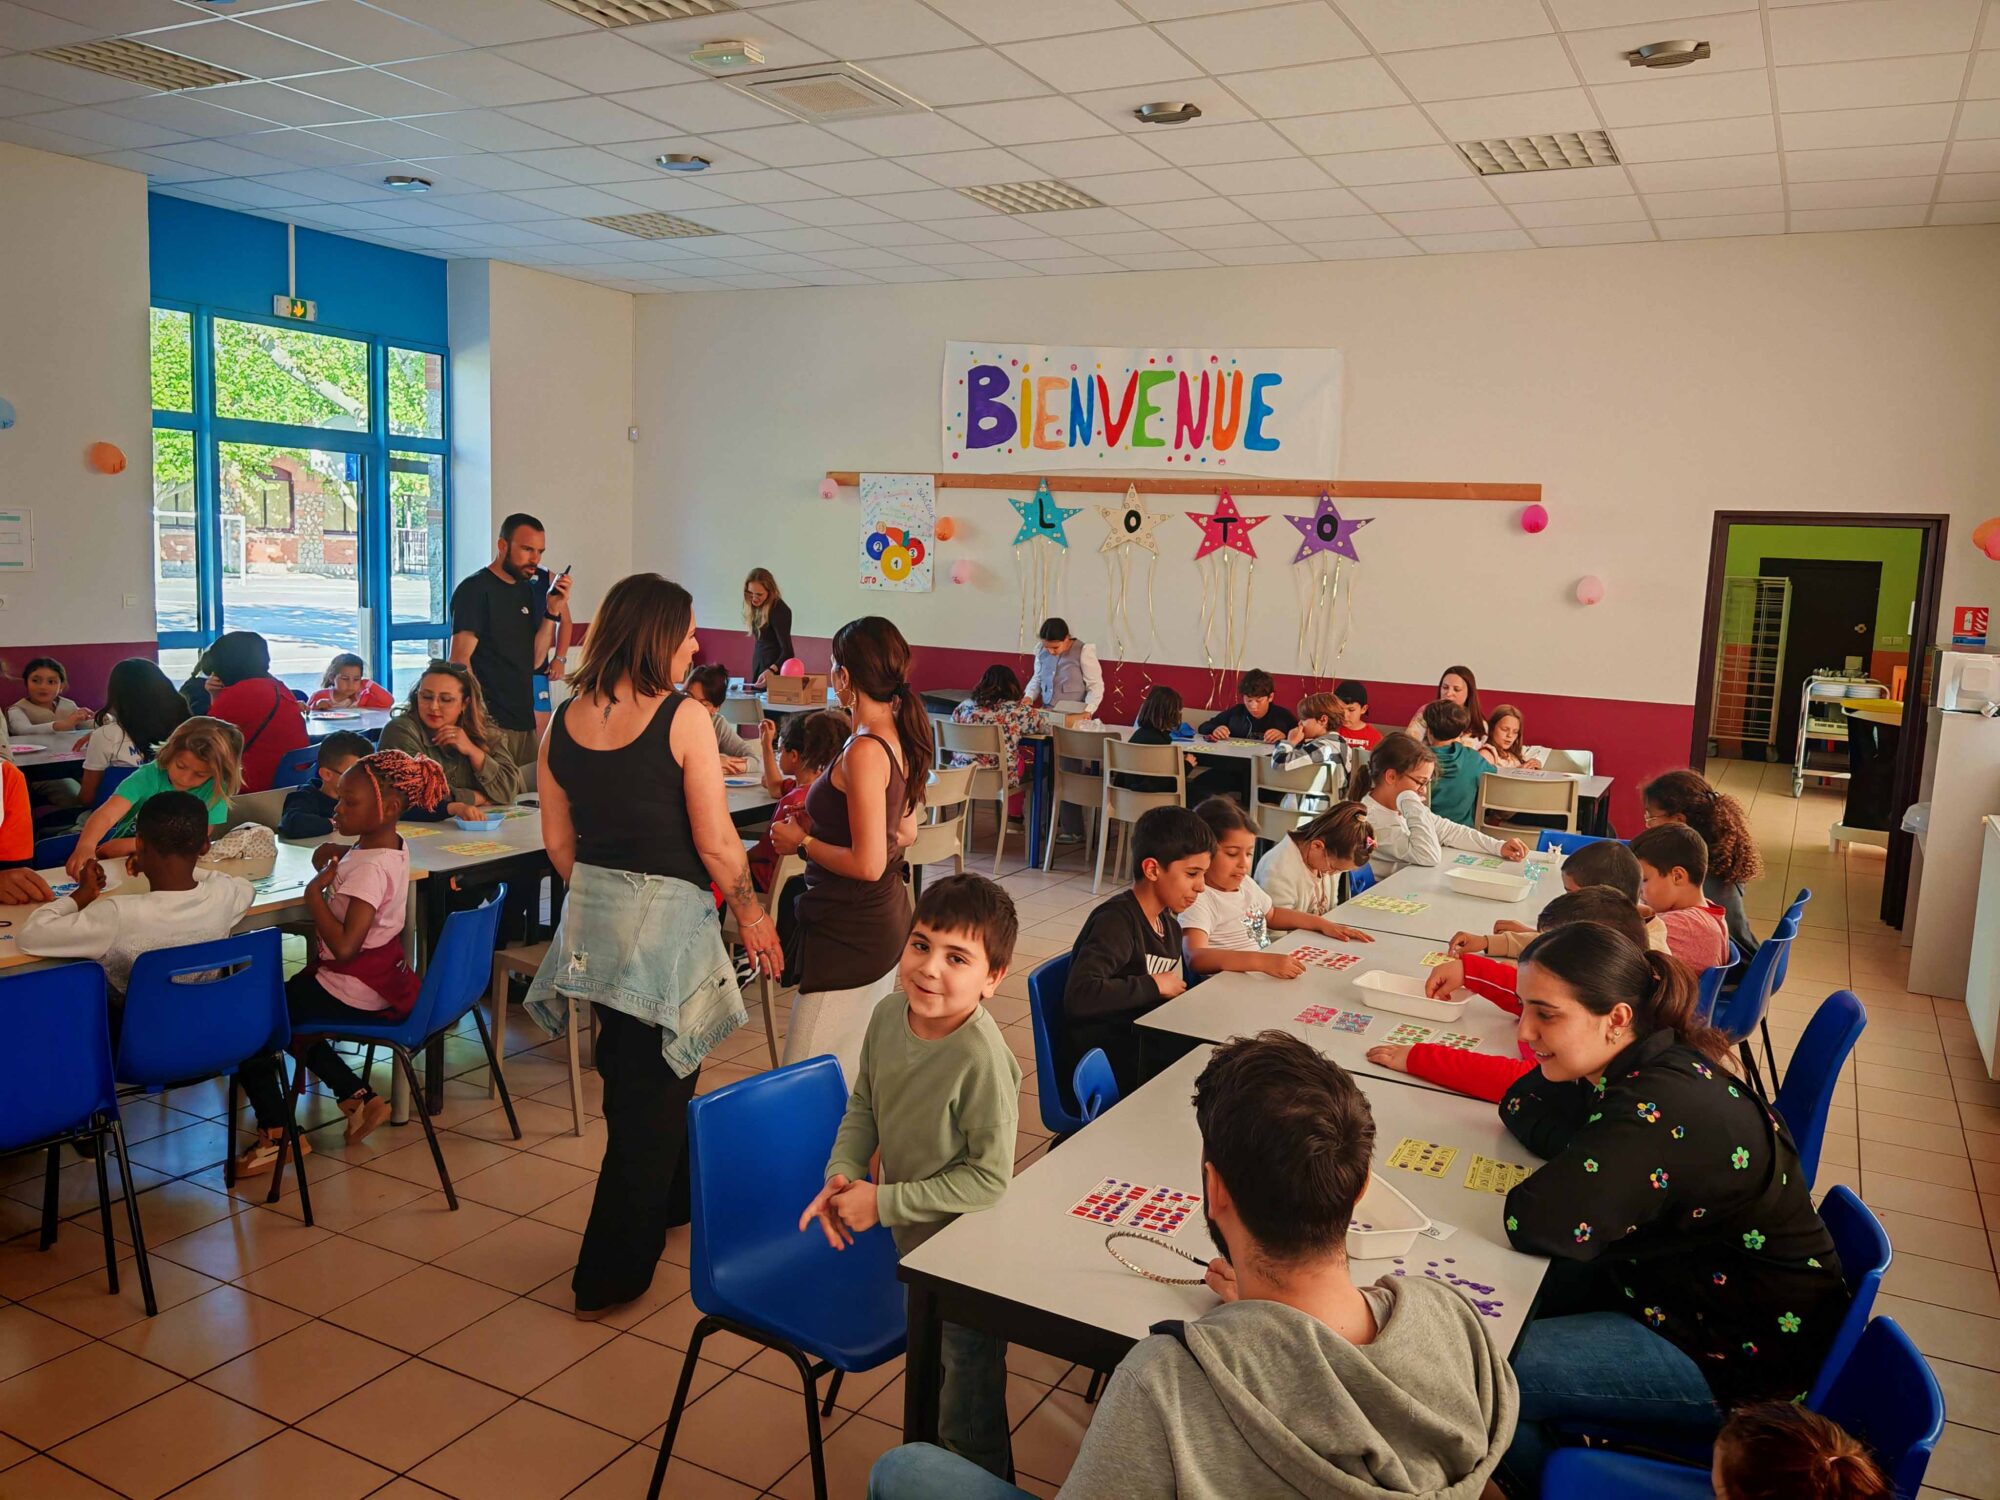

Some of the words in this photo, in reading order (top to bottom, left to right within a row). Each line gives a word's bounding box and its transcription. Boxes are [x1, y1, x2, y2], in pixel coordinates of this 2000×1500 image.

[875, 542, 881, 551] 2
[910, 548, 916, 557] 3
[893, 559, 899, 569] 1
[859, 575, 877, 584] LOTO
